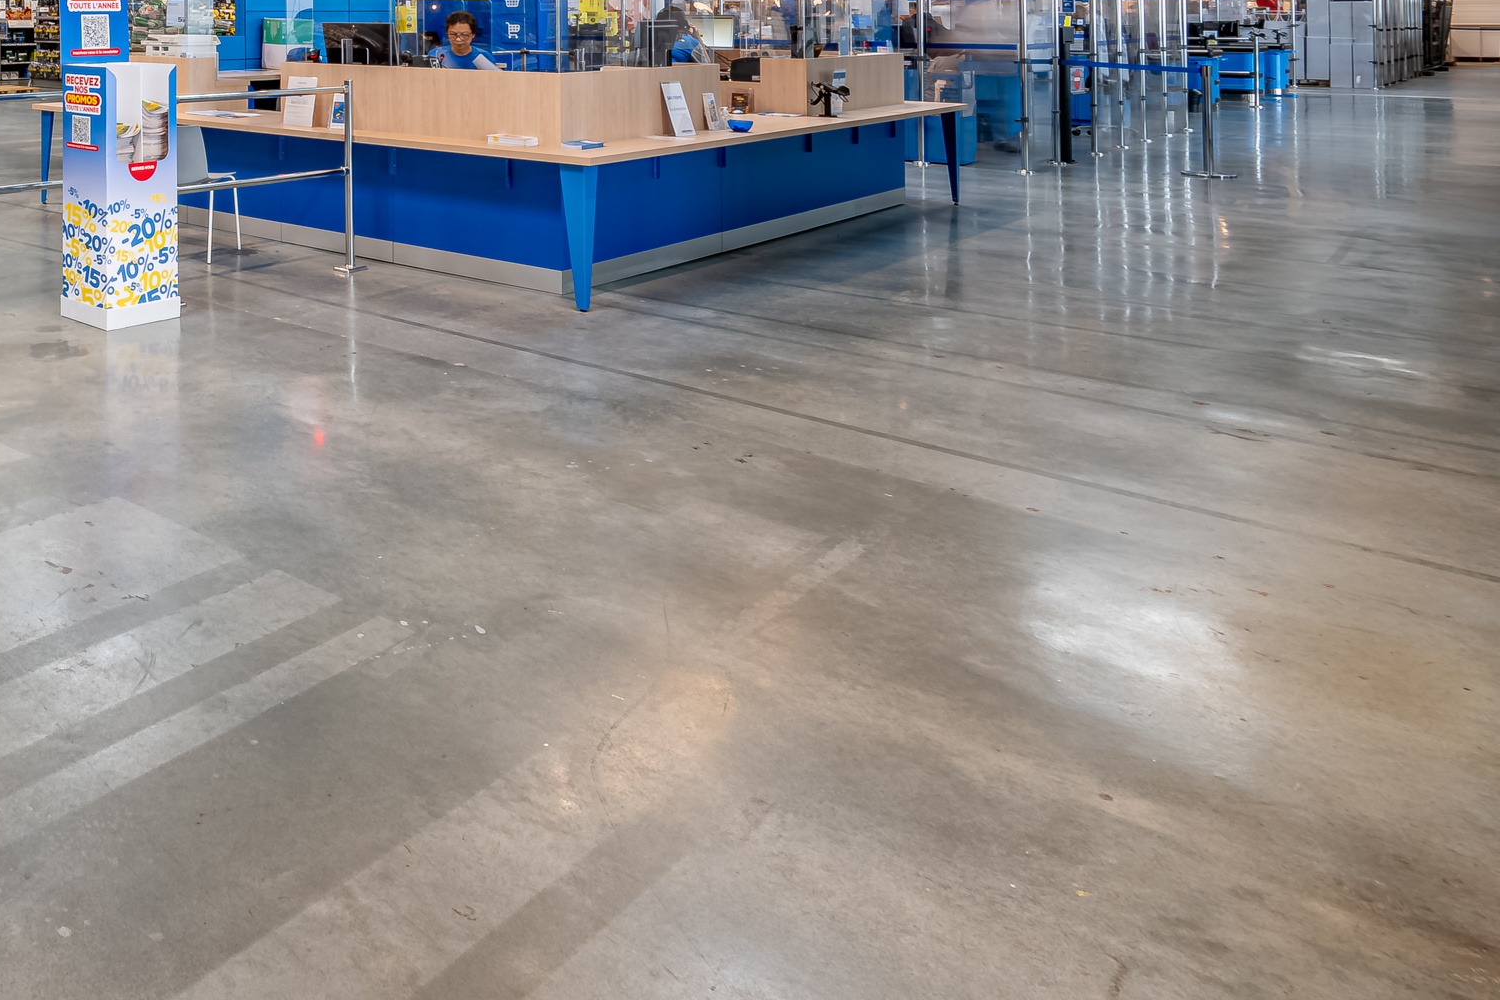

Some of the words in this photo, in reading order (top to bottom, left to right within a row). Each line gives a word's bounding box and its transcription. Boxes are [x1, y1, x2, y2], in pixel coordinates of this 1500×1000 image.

[69, 1, 92, 10] TOUTE
[93, 1, 119, 10] L'ANNÉE
[65, 75, 99, 87] RECEVEZ
[74, 85, 88, 94] NOS
[67, 95, 98, 105] PROMOS
[66, 104, 80, 112] TOUTE
[81, 105, 99, 114] L'ANNÉE
[68, 186, 79, 199] -5%
[122, 208, 173, 248] -20%
[76, 265, 115, 295] -15%
